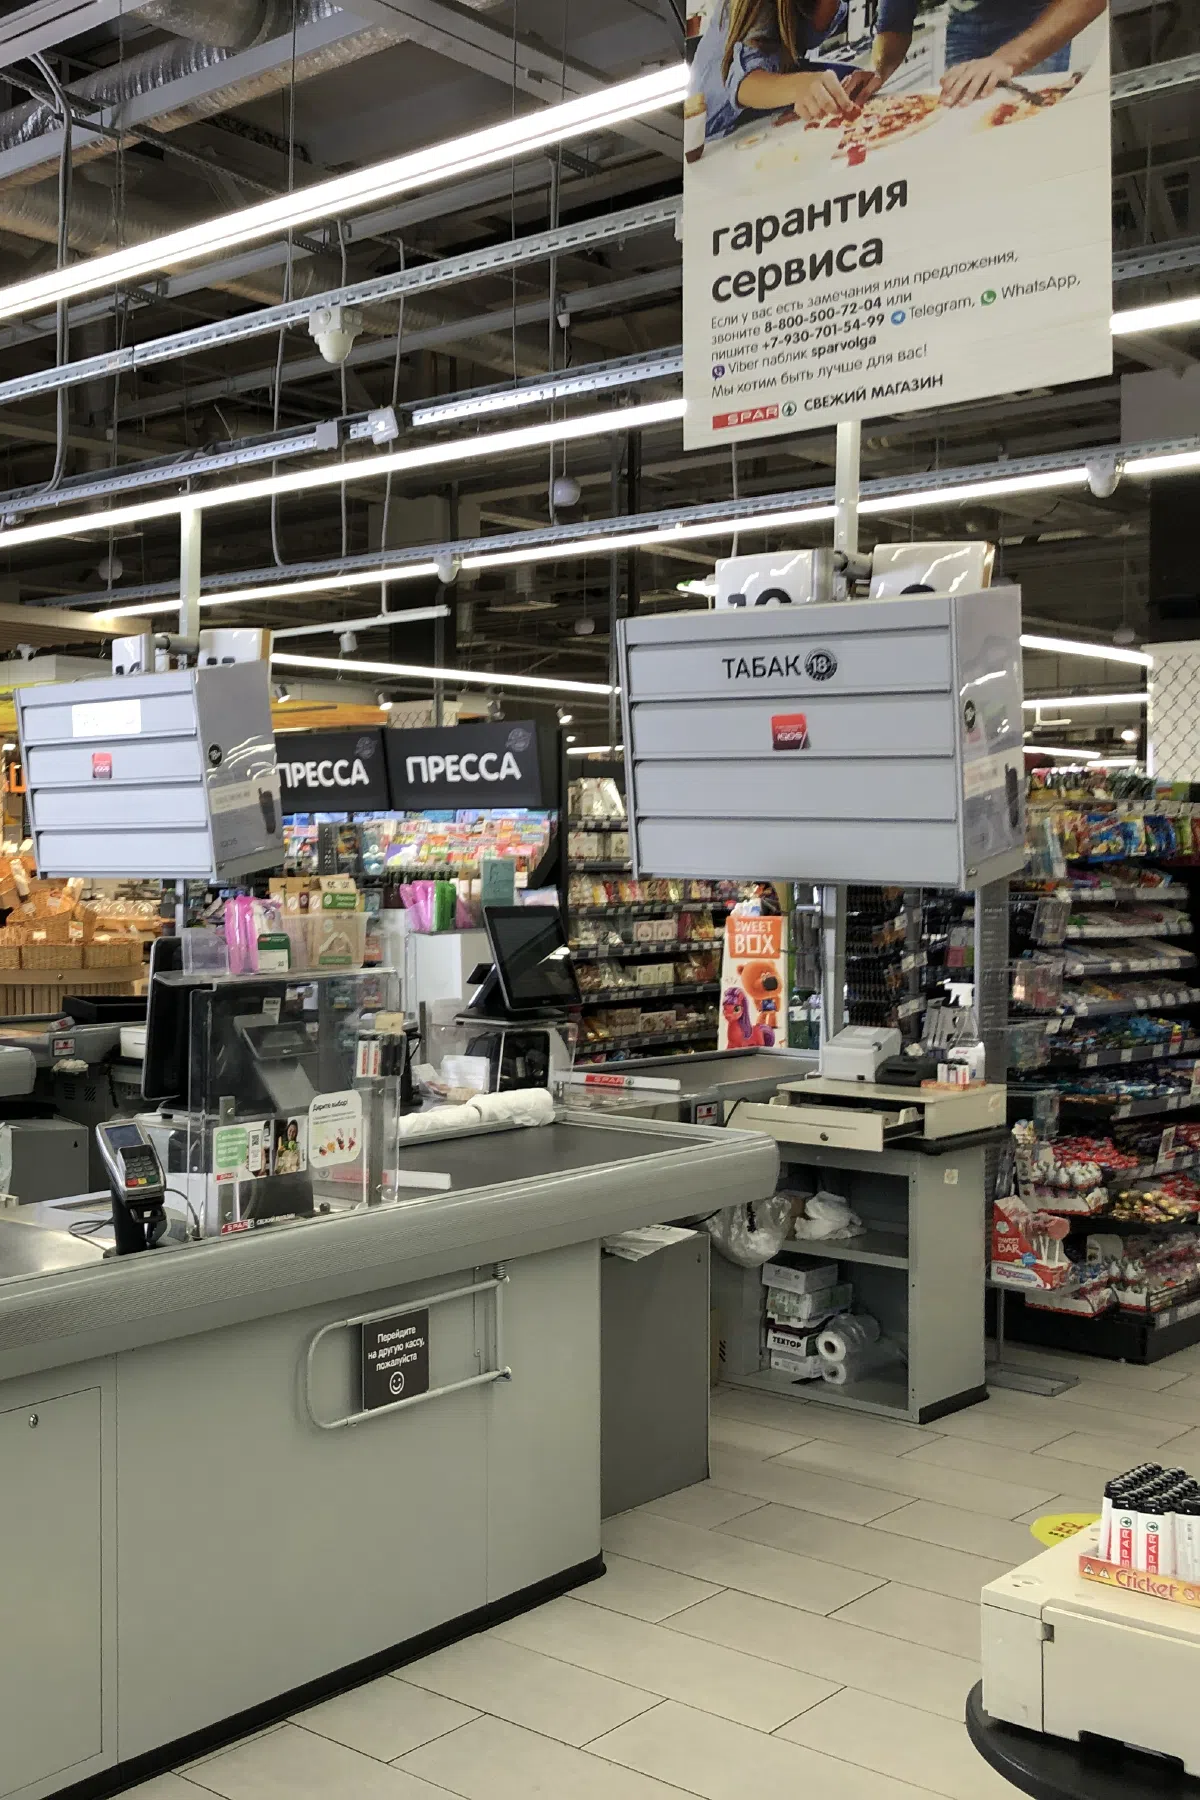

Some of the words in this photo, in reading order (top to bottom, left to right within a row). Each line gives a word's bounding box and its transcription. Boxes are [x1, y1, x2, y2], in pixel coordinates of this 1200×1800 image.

[712, 179, 907, 256] гарантия
[712, 237, 883, 303] сервиса
[711, 314, 738, 329] Если
[741, 312, 749, 325] у
[751, 306, 773, 320] вас
[776, 300, 803, 314] есть
[807, 282, 880, 309] замечания
[884, 274, 910, 291] или
[913, 251, 1019, 284] предложения,
[711, 343, 759, 362] пишите
[761, 313, 885, 350] +7-930-701-54-99
[909, 296, 976, 320] Telegram,
[1001, 274, 1081, 299] WhatsApp,
[711, 327, 761, 346] звоните
[764, 299, 882, 334] 8-800-500-72-04
[886, 292, 912, 307] или
[728, 358, 759, 375] Viber
[762, 348, 808, 367] паблик
[811, 334, 877, 359] sparvolga
[711, 384, 734, 399] Мы
[736, 375, 777, 394] хотим
[780, 369, 814, 385] быть
[816, 359, 863, 379] лучше
[866, 354, 894, 371] для
[897, 343, 928, 362] вас!
[804, 386, 867, 412] СВЕЖИЙ
[871, 374, 943, 400] МАГАЗИН
[727, 405, 778, 426] SPAR
[721, 654, 801, 679] ТАБАК
[277, 758, 370, 788] ПРЕССА
[405, 751, 522, 784] ПРЕССА
[734, 921, 773, 932] SWEET
[734, 934, 775, 956] BOX
[593, 1076, 624, 1085] SPAR
[227, 1222, 248, 1231] SPAR
[368, 1351, 377, 1360] на
[377, 1343, 404, 1359] другую
[404, 1336, 425, 1348] кассу,
[377, 1325, 416, 1343] Перейдите
[772, 1336, 801, 1349] TEXTOP
[375, 1352, 417, 1371] пожалуйста
[1121, 1529, 1130, 1567] SPAR
[1148, 1534, 1157, 1573] SPAR
[1115, 1569, 1178, 1598] Cricket
